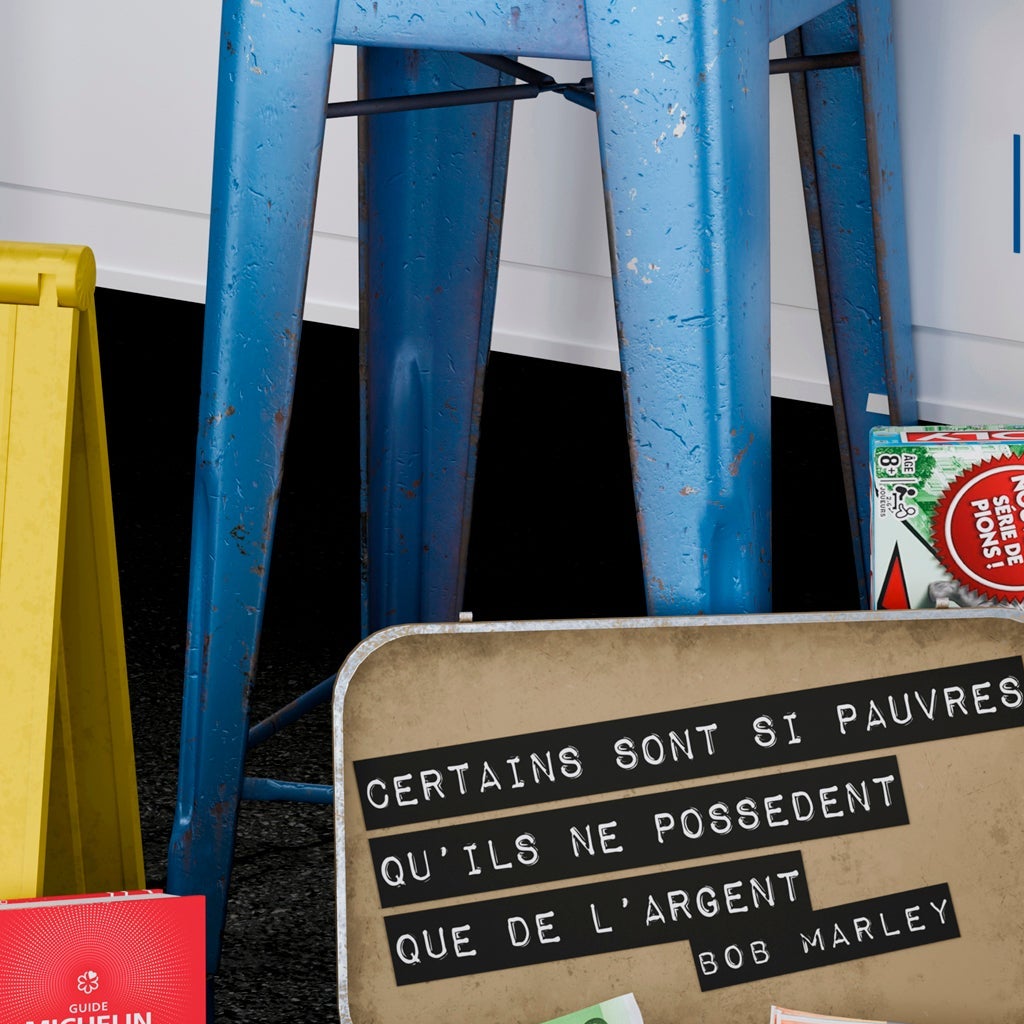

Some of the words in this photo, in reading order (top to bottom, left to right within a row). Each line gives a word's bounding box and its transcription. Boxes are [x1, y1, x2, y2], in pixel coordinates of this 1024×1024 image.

[880, 455, 899, 475] 8+
[903, 453, 915, 473] ÂGE
[971, 500, 1001, 558] PIONS
[993, 495, 1017, 541] SÉRIE
[1003, 543, 1024, 566] DE
[366, 745, 583, 811] CERTAINS
[614, 724, 718, 771] SONT
[753, 712, 802, 749] SI
[837, 676, 1024, 734] PAUVRES
[381, 833, 540, 888] QU'ILS
[570, 820, 624, 858] NE
[655, 774, 896, 845] POSSEDENT
[396, 923, 477, 967] QUE
[507, 910, 561, 948] DE
[592, 869, 799, 937] L'ARGENT
[698, 940, 771, 978] BOB
[801, 899, 950, 955] MARLEY
[69, 1002, 108, 1013] GUIDE
